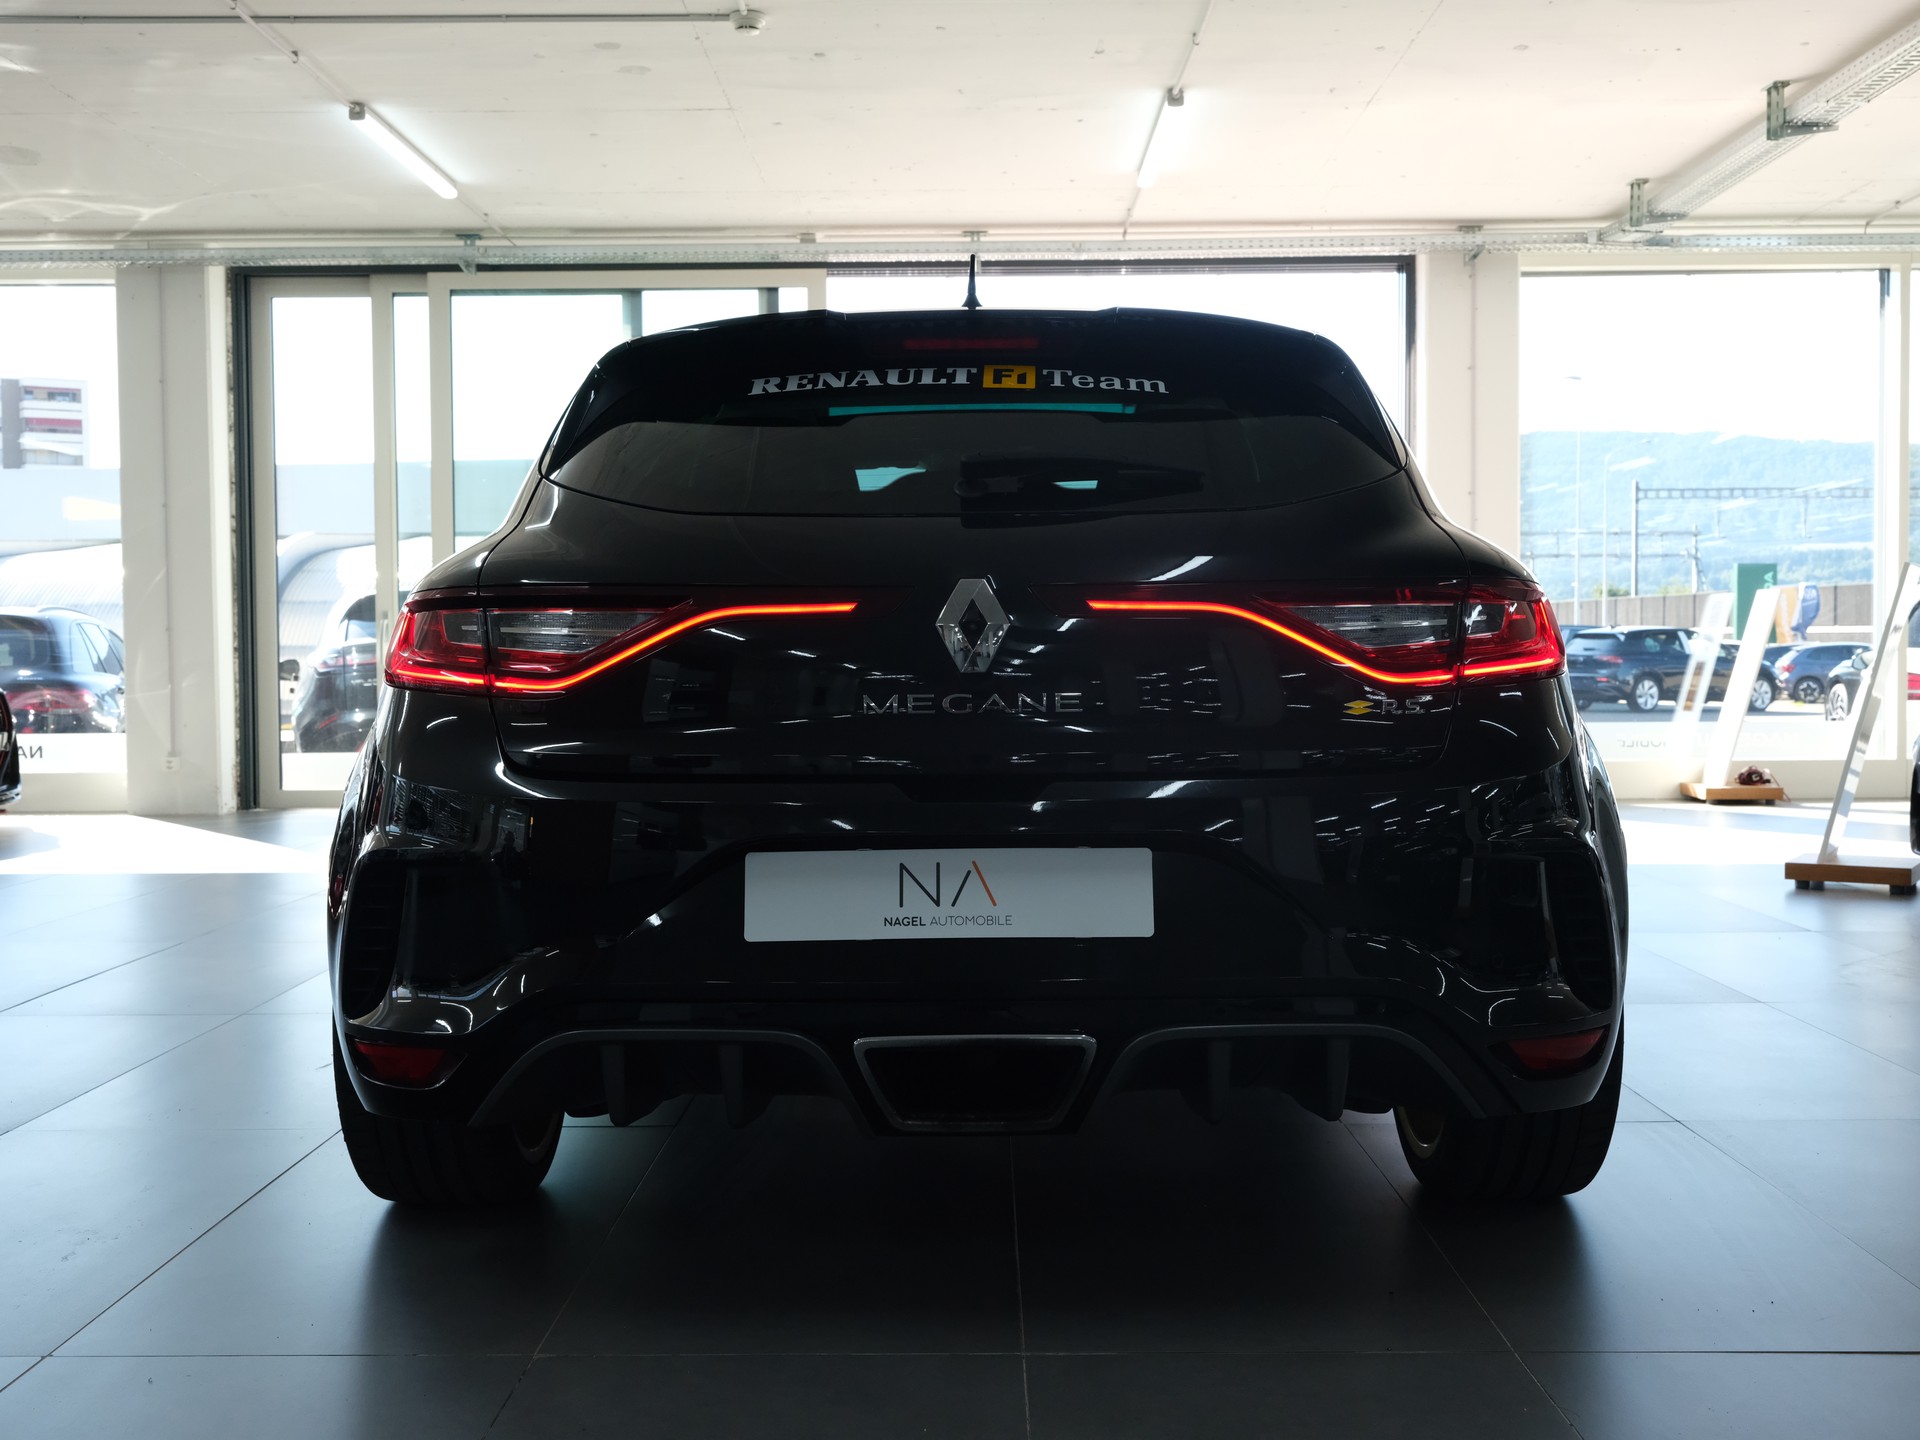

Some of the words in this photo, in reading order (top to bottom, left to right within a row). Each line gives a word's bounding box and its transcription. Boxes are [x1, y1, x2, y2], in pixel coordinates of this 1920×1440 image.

[748, 367, 979, 396] RENAULT
[993, 369, 1028, 385] F1
[1043, 369, 1169, 394] Team
[863, 692, 1082, 714] MEGANE
[884, 917, 926, 927] NAGEL
[930, 915, 1013, 926] AUTOMOBILE
